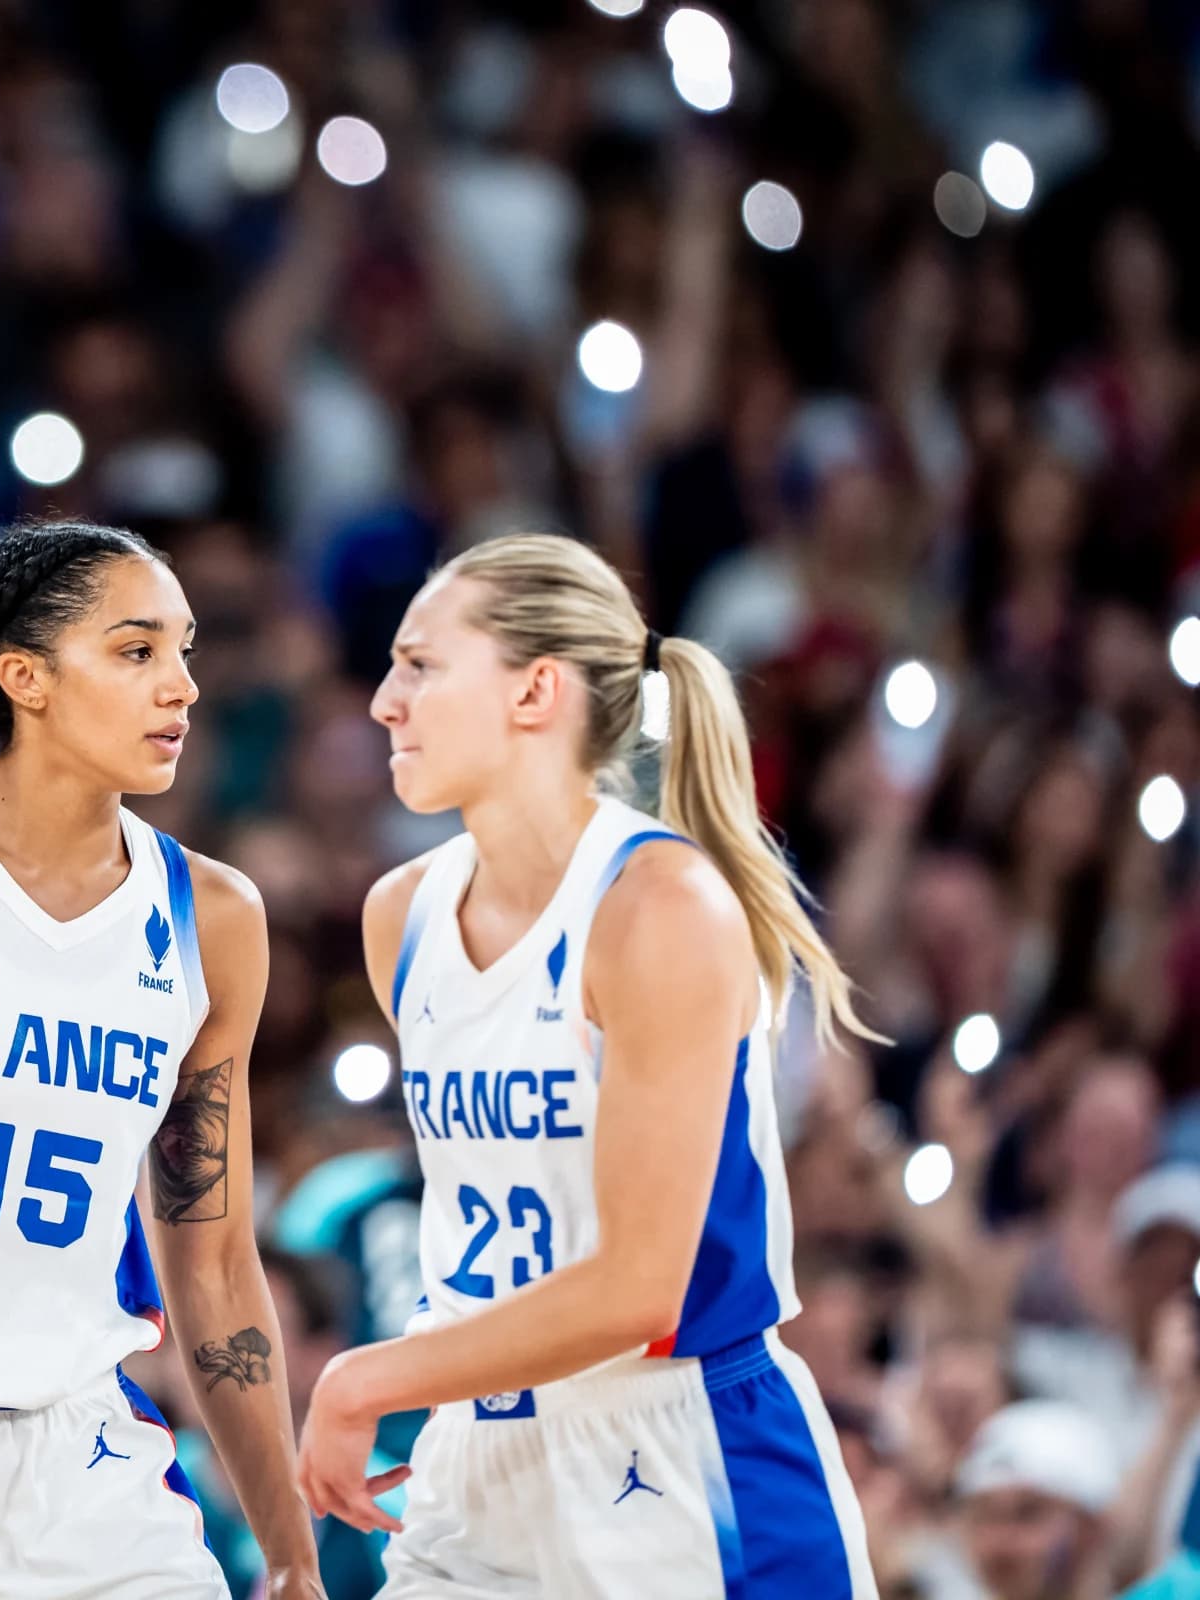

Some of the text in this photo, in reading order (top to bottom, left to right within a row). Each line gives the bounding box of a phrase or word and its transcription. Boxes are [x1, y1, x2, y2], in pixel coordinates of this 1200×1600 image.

[138, 971, 174, 994] FRANCE
[402, 1070, 583, 1139] RANCE
[441, 1184, 553, 1299] 23
